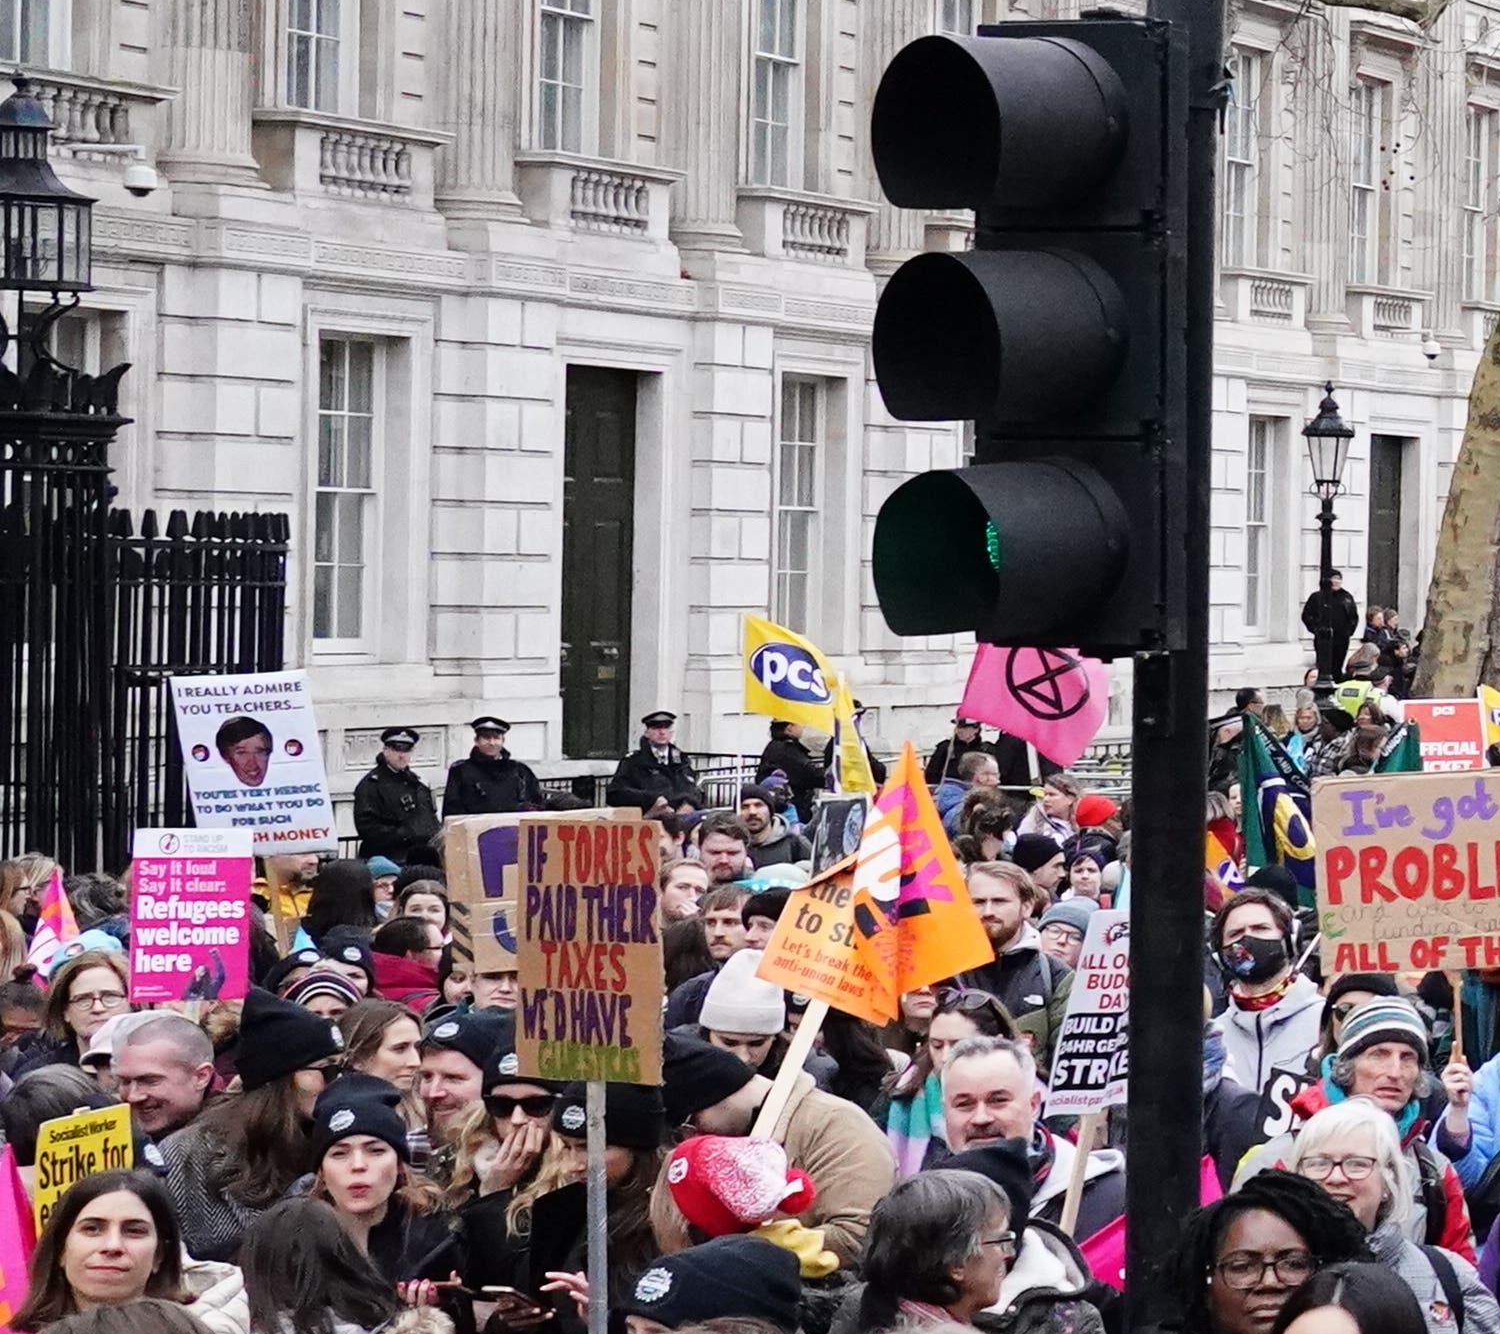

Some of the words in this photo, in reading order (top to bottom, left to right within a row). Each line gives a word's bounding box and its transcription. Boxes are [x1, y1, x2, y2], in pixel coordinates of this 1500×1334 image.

[762, 649, 827, 697] pcs
[1421, 778, 1499, 840] got
[527, 825, 548, 883] IF
[558, 825, 656, 885] TORIES
[136, 922, 239, 945] welcome
[137, 896, 245, 923] Refugees
[526, 884, 578, 942] PAID
[582, 884, 658, 944] THEIR
[136, 949, 192, 973] here
[540, 941, 627, 993] TAXES
[1335, 942, 1398, 972] ALL
[1409, 936, 1449, 967] OF
[571, 988, 632, 1048] HAVE
